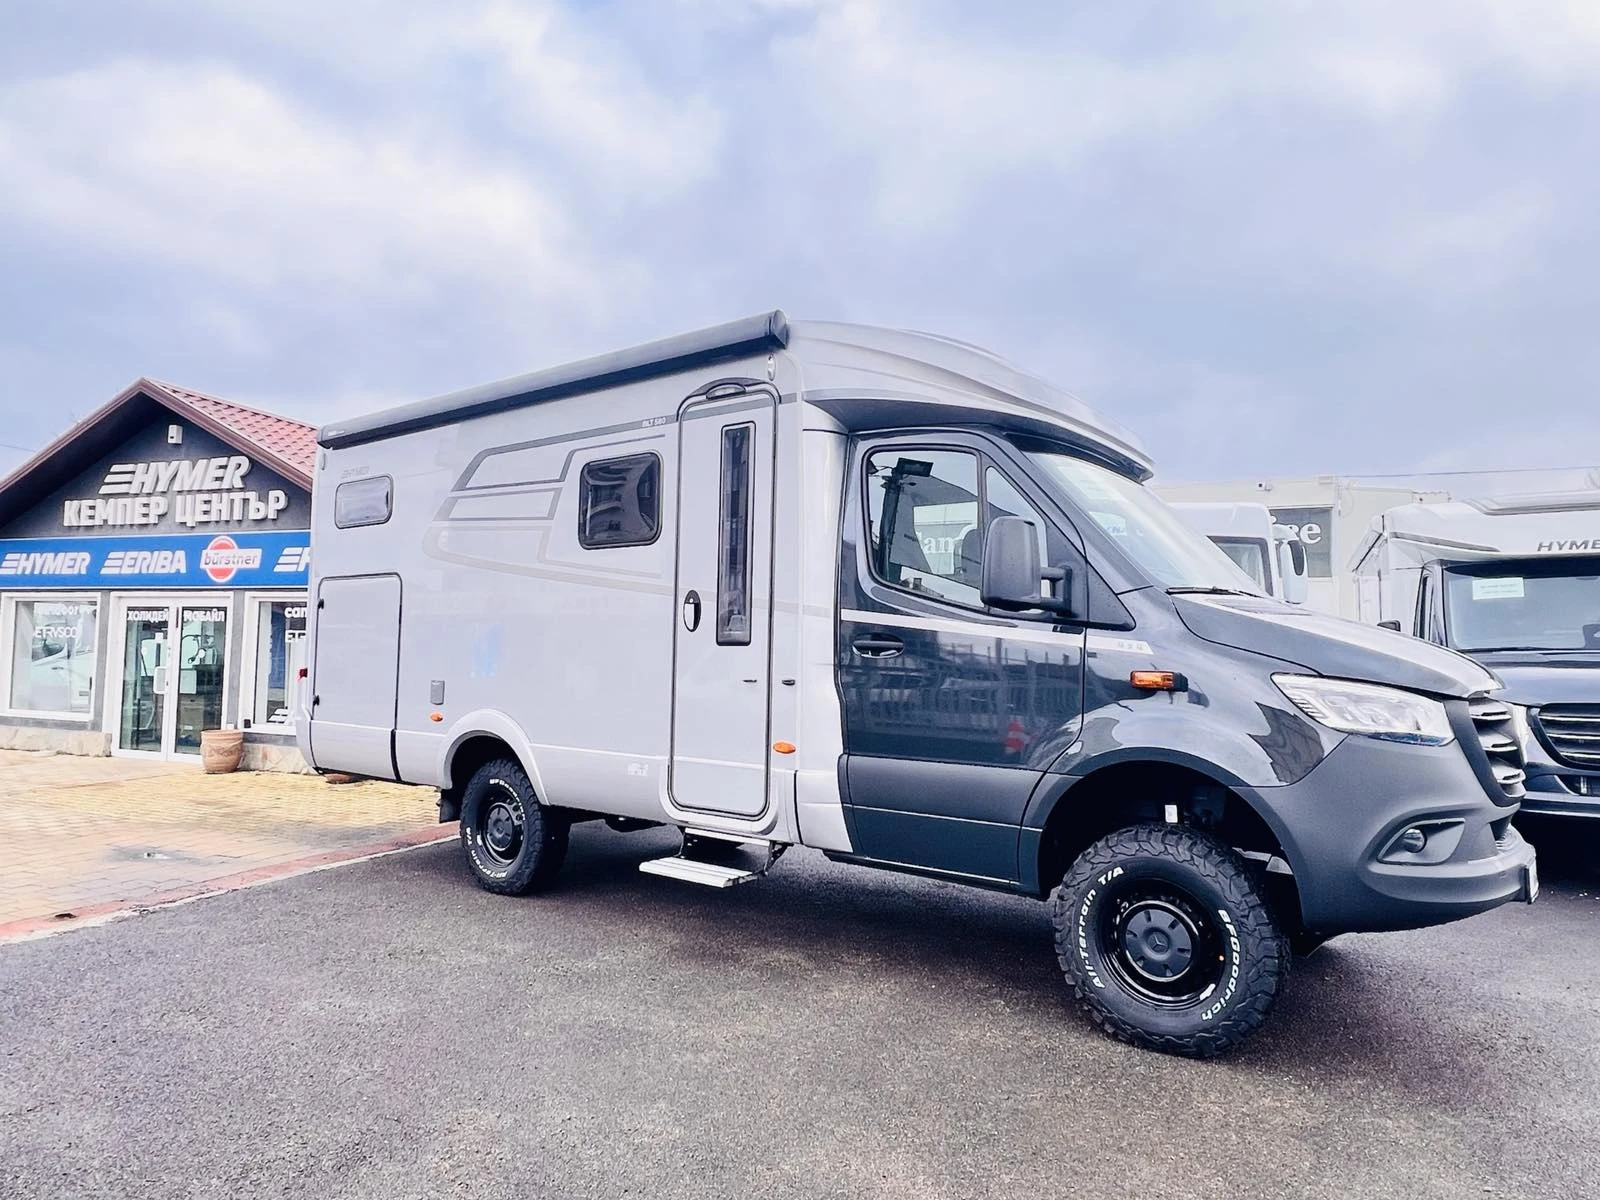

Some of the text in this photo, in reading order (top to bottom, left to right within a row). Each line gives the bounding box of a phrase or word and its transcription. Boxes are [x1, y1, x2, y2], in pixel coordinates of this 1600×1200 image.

[128, 456, 250, 494] HYMER
[63, 489, 287, 527] КЕМПЕР ЦЕНТЪР
[16, 552, 91, 575] HYMER
[119, 550, 187, 574] ERIBA
[204, 553, 258, 566] bürstner
[1079, 866, 1124, 988] All-Terrain T/A
[1201, 909, 1240, 1021] BFGoodrich
